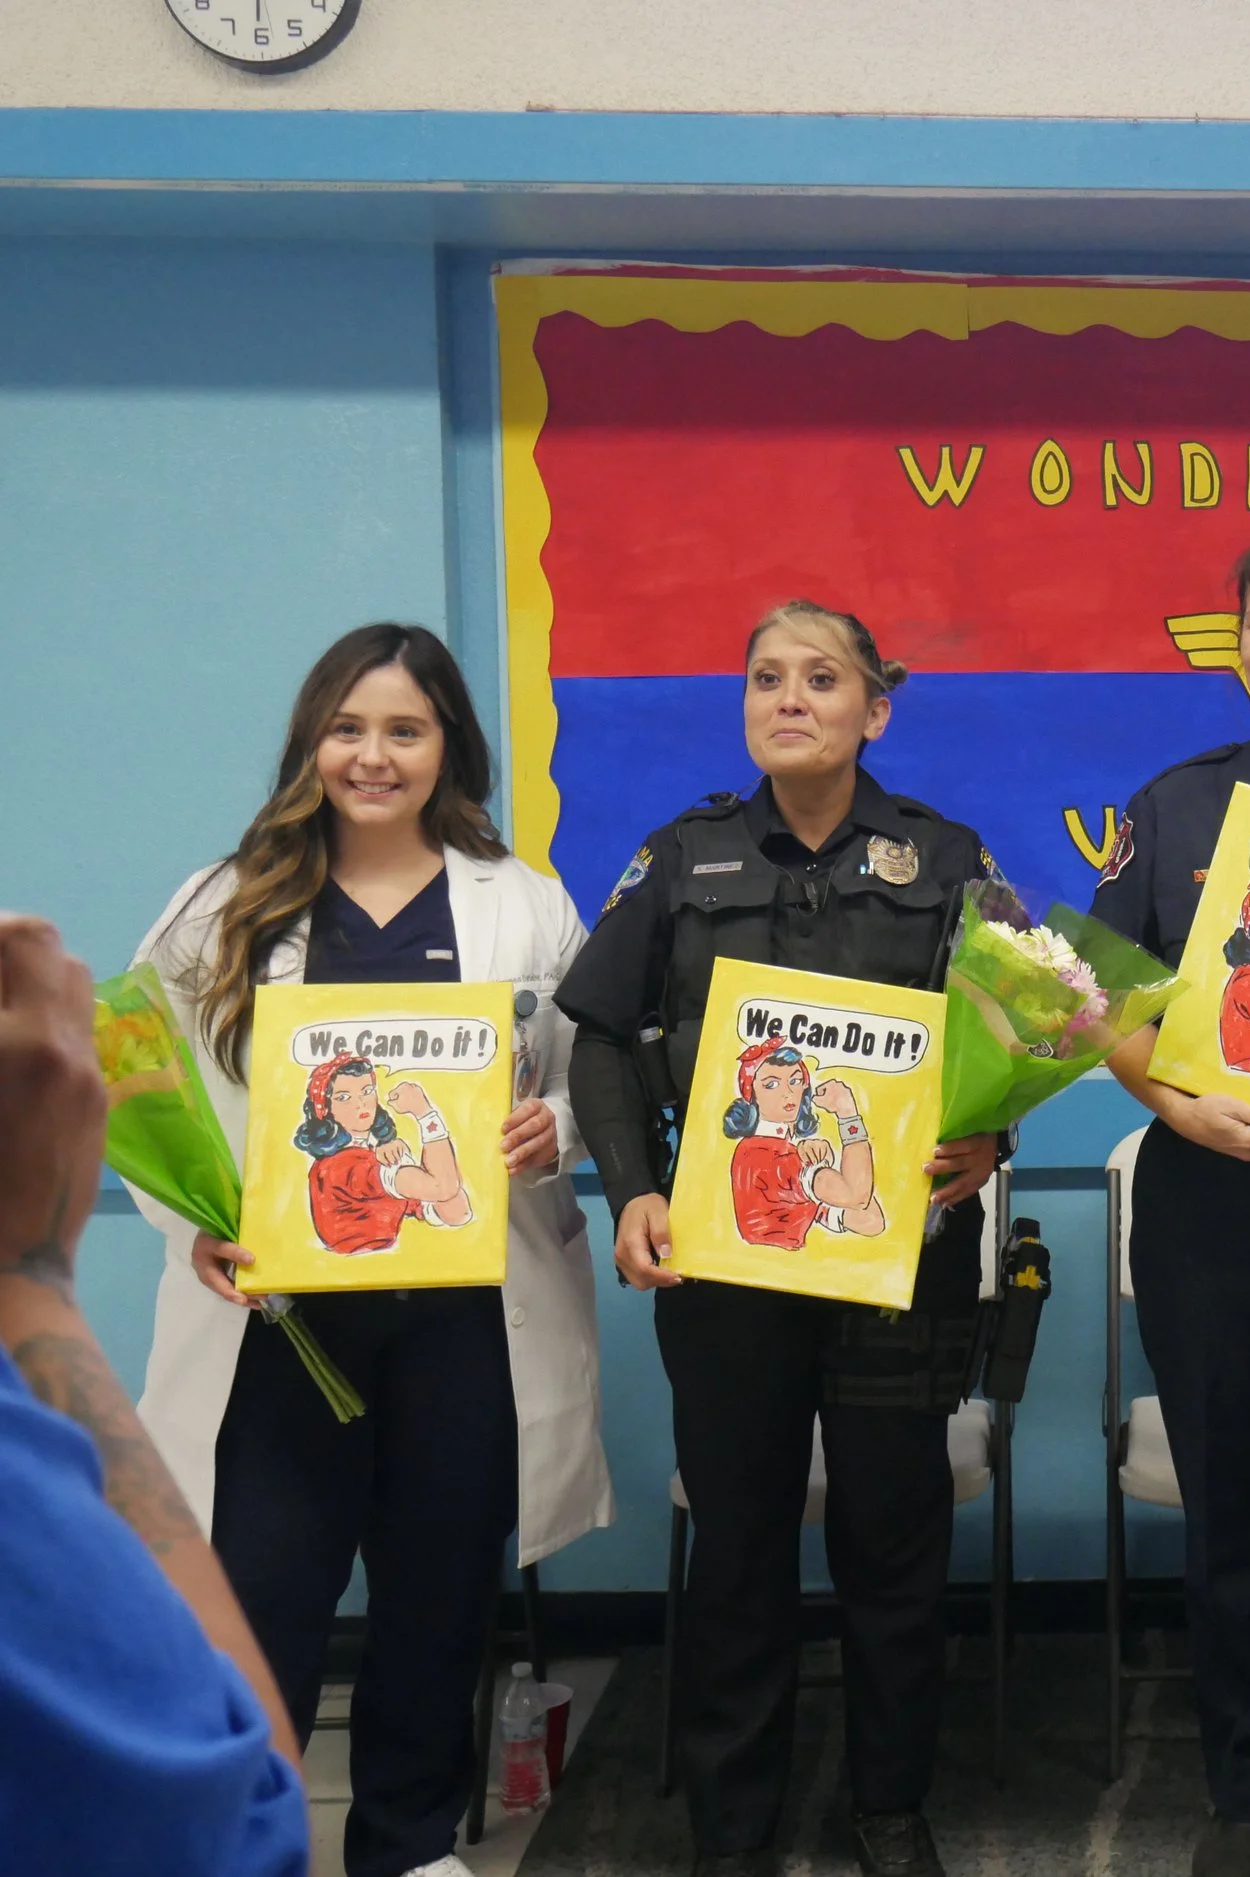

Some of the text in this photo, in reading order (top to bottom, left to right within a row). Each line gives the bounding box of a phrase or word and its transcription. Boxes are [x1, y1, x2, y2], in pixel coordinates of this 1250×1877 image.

[220, 18, 236, 35] 7
[287, 19, 302, 37] 5
[254, 28, 269, 46] 6
[746, 1007, 783, 1038] We
[789, 1015, 836, 1048] Can
[842, 1022, 875, 1056] Do
[309, 1031, 347, 1052] We
[356, 1030, 404, 1057] Can
[412, 1029, 444, 1058] Do
